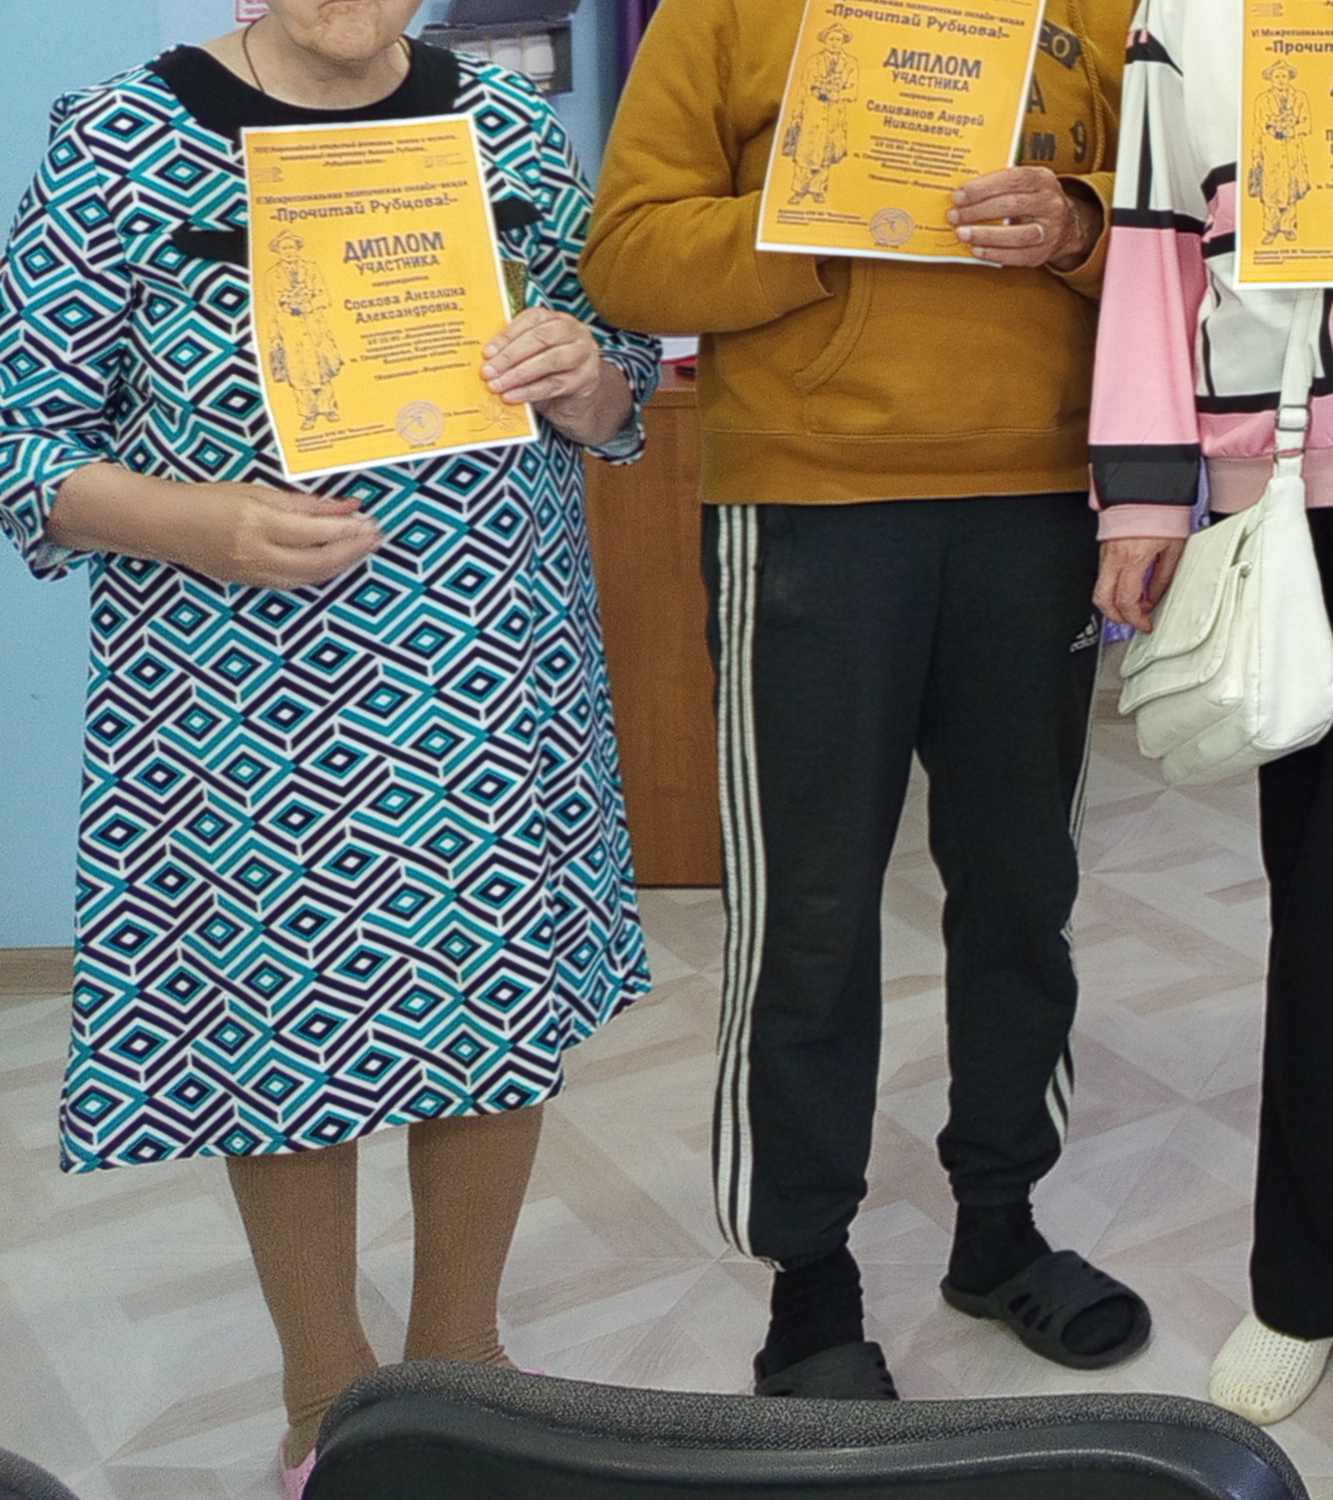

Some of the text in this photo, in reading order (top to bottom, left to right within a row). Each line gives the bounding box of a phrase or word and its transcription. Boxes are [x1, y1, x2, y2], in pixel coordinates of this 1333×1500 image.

[883, 48, 982, 79] ДИПЛОМ
[892, 71, 969, 92] УЧАСТНИКА
[866, 100, 984, 127] Селиванов Андрей
[343, 232, 445, 264] ДИПЛОМ
[356, 255, 440, 275] УЧАСТНИКА
[344, 296, 401, 311] Соскова
